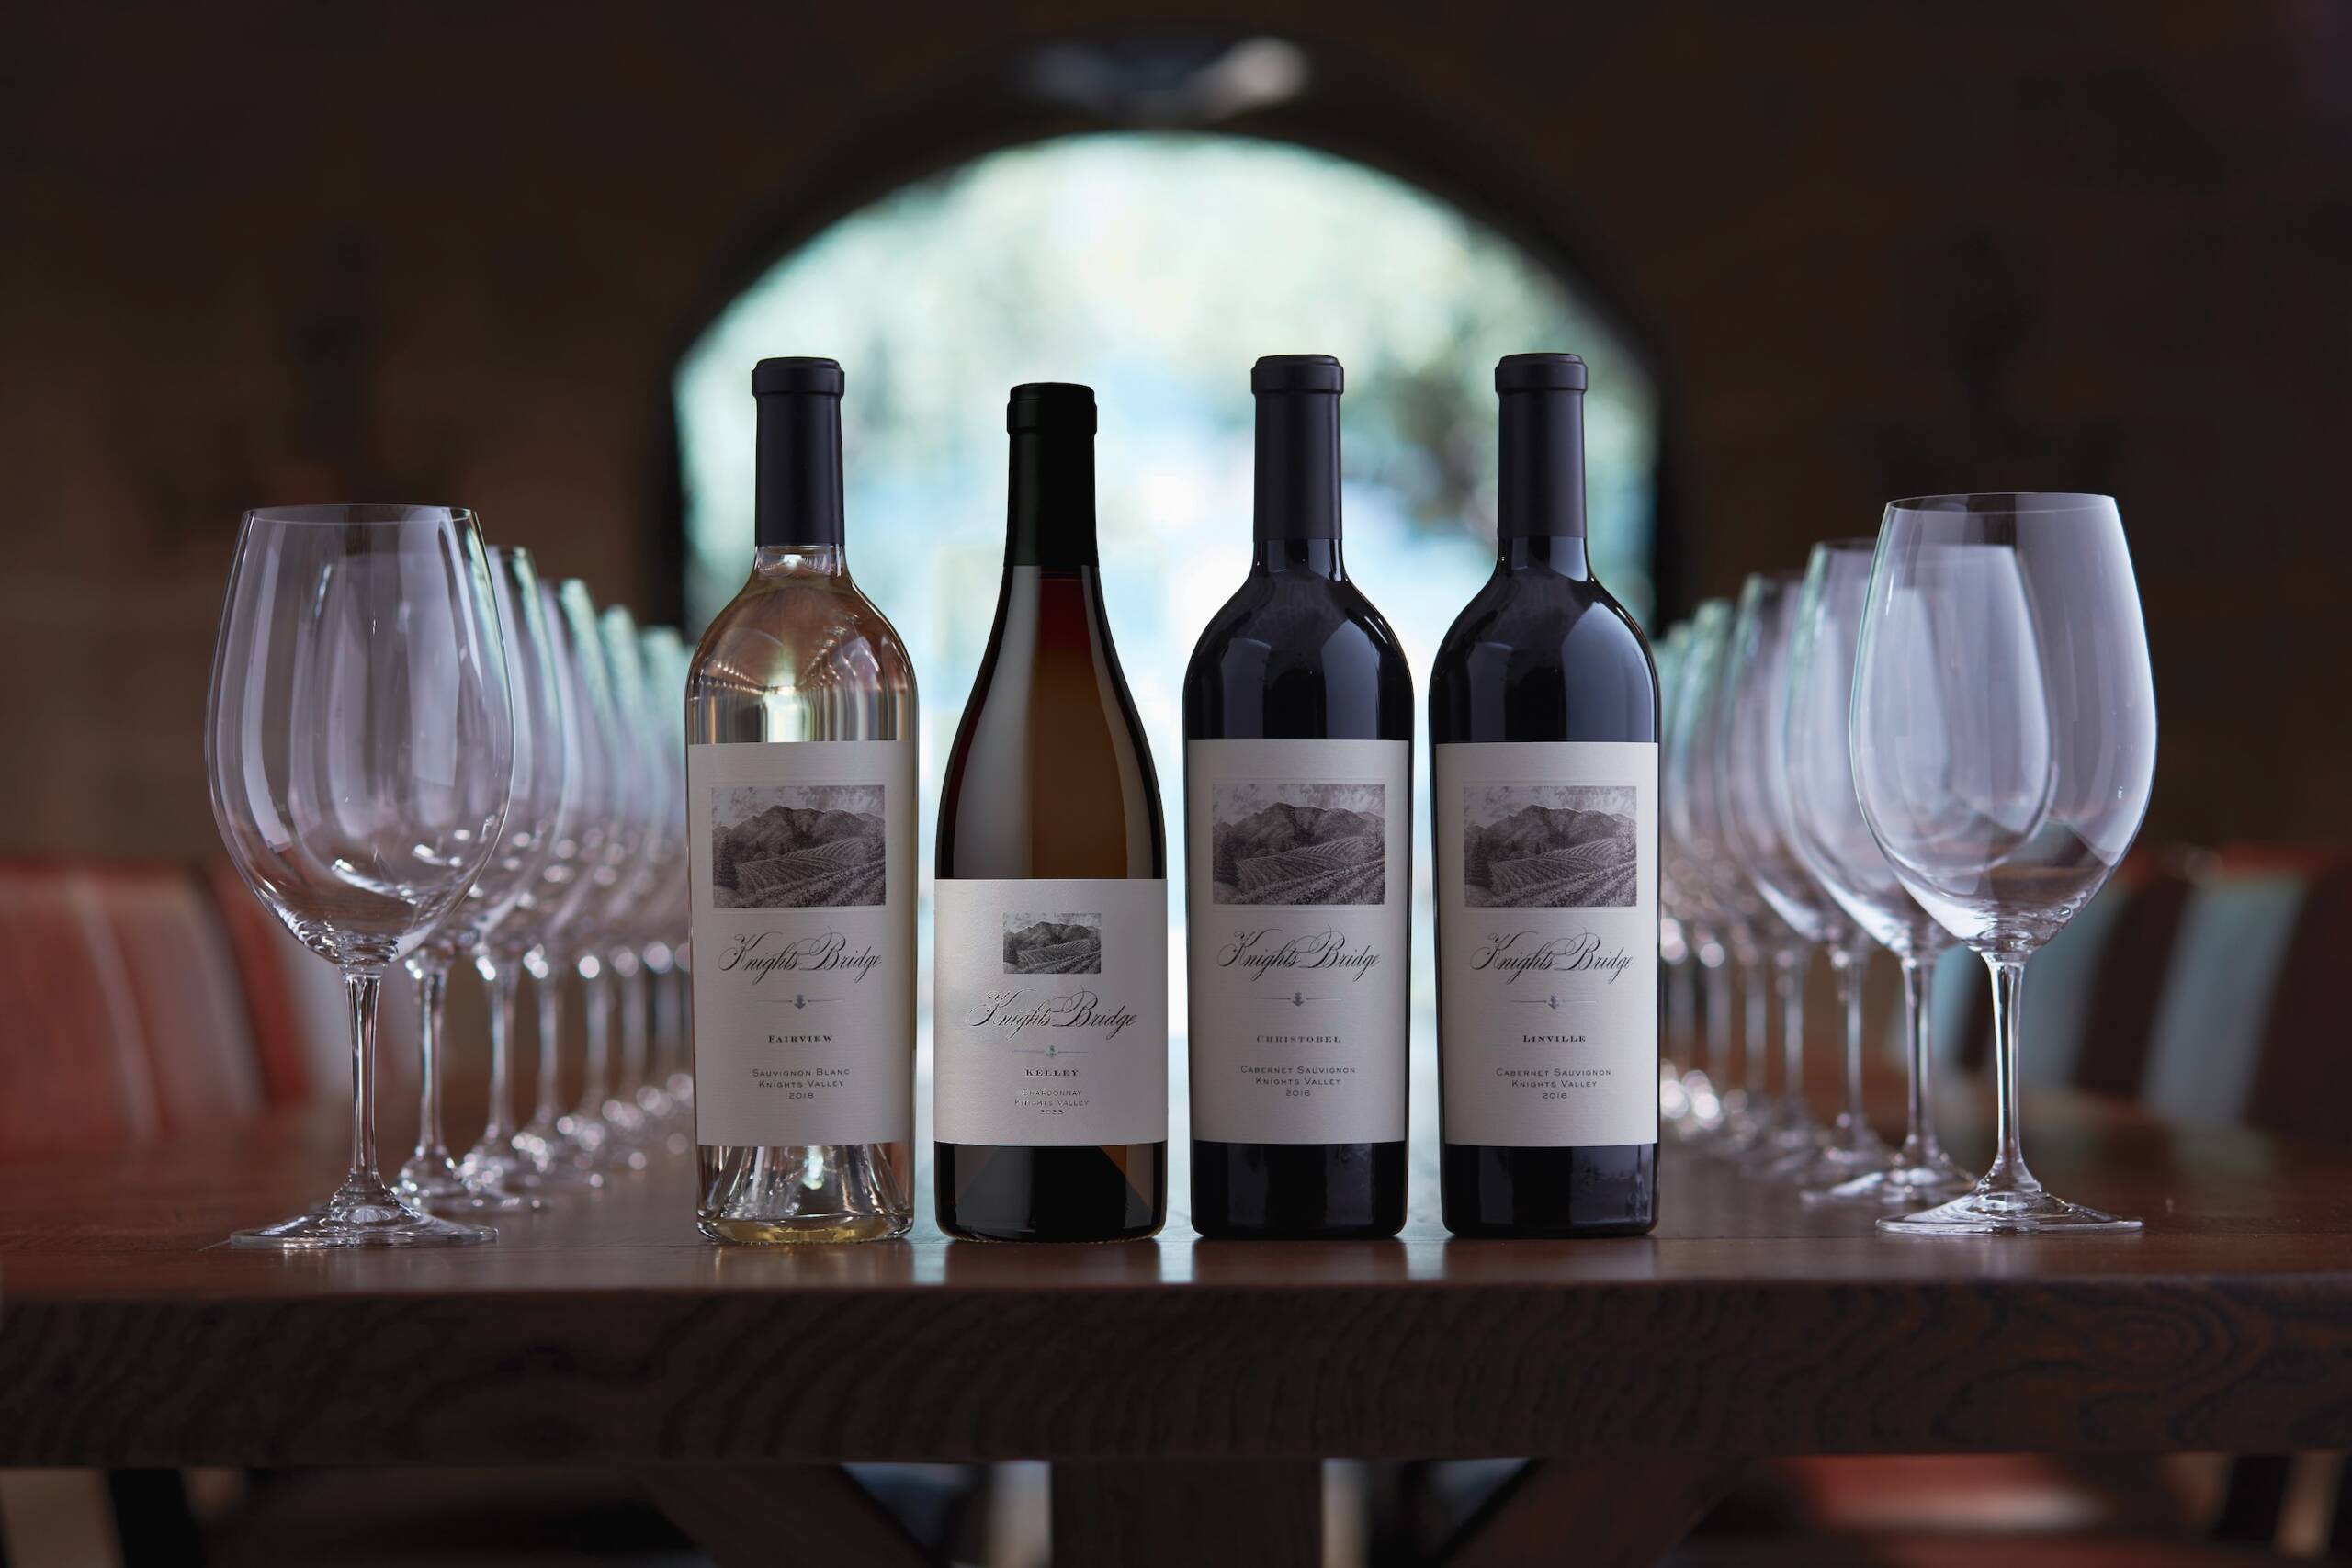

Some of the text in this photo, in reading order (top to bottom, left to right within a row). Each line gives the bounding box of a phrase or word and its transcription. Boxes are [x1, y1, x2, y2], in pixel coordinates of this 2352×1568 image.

[718, 926, 882, 985] Knights Bridge
[1217, 924, 1381, 982] Knights Bridge
[1470, 927, 1634, 985] Knights Bridge
[968, 985, 1138, 1040] Knights Bridge
[1257, 1035, 1341, 1043] CHRISTOBEL
